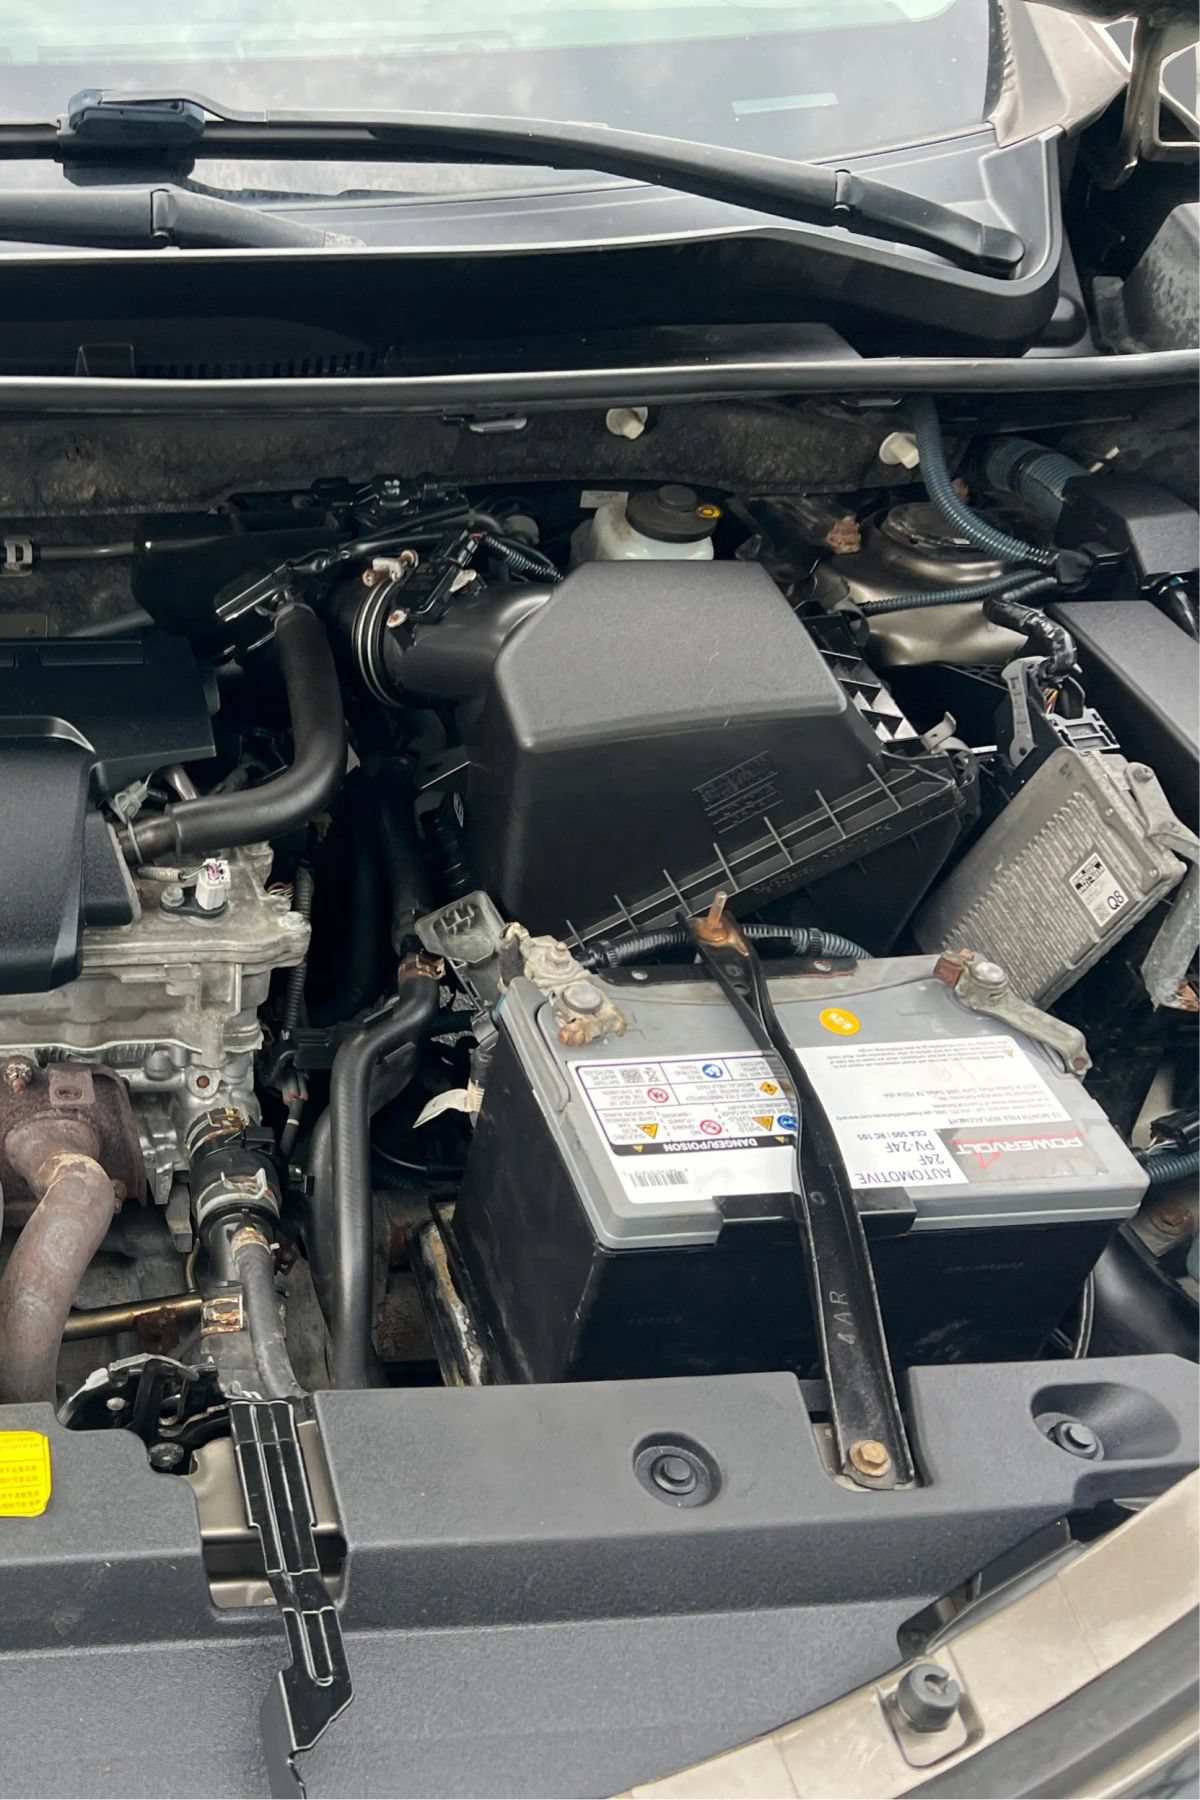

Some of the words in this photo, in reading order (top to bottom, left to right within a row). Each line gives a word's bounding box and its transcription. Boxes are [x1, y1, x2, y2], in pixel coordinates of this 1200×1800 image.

[1107, 890, 1124, 910] Q8
[873, 1132, 886, 1140] RC
[908, 1130, 927, 1138] CCA
[662, 1138, 758, 1152] DANGER/POISON
[884, 1139, 935, 1154] PV-24F
[956, 1137, 1083, 1155] POWERVOLT
[918, 1153, 944, 1166] 24F
[854, 1167, 951, 1185] AUTOMOTIVE
